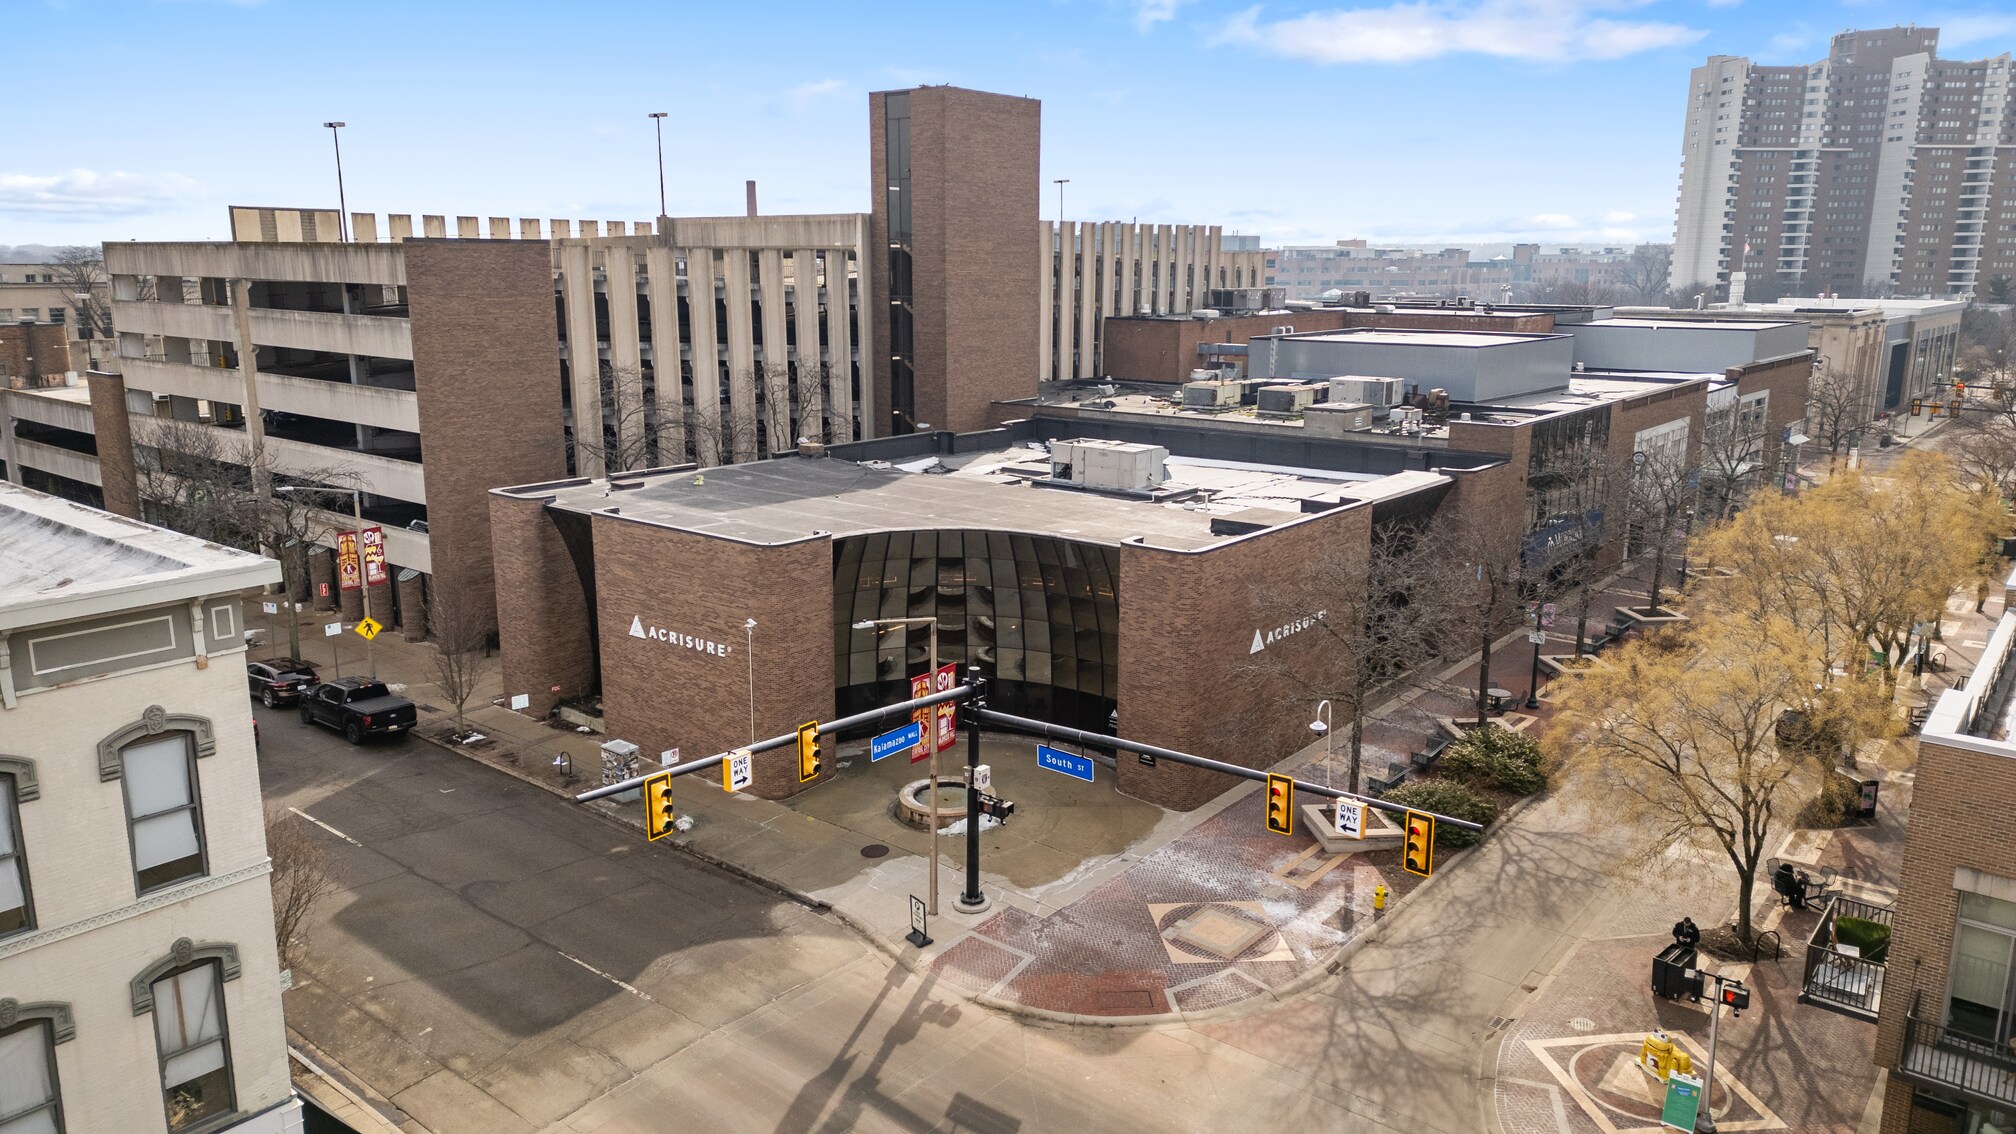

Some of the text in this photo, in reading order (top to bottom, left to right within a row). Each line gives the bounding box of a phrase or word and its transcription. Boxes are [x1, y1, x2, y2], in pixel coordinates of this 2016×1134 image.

[649, 626, 726, 657] ACRISURE
[873, 736, 906, 754] Kalamazoo
[733, 756, 748, 768] ONE
[1046, 754, 1085, 772] South ST
[733, 765, 748, 777] WAY
[1340, 804, 1358, 816] ONE
[1340, 812, 1358, 824] WAY
